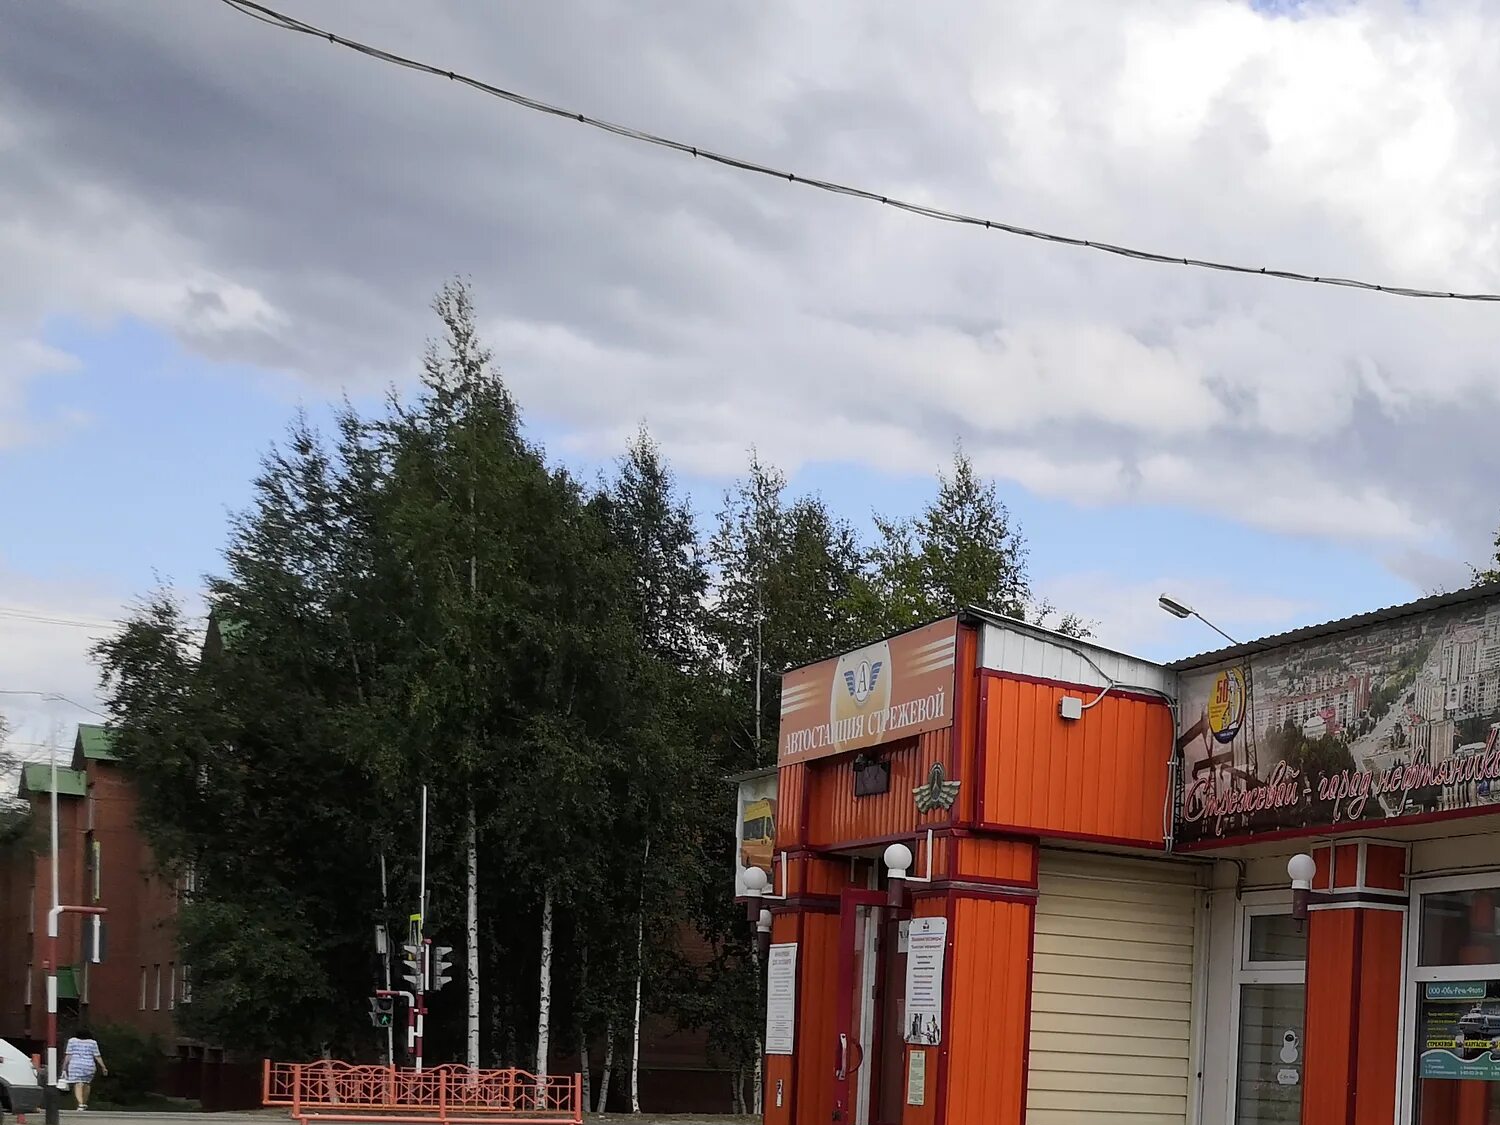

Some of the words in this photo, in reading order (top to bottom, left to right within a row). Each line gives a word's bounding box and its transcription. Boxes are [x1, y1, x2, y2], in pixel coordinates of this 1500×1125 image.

[784, 714, 865, 756] АВТОСТАНЦИЯ
[868, 685, 945, 737] СТРЕЖЕВОЙ
[1216, 679, 1229, 704] 50
[1184, 760, 1300, 836] Стрежевой
[1318, 768, 1374, 821] город
